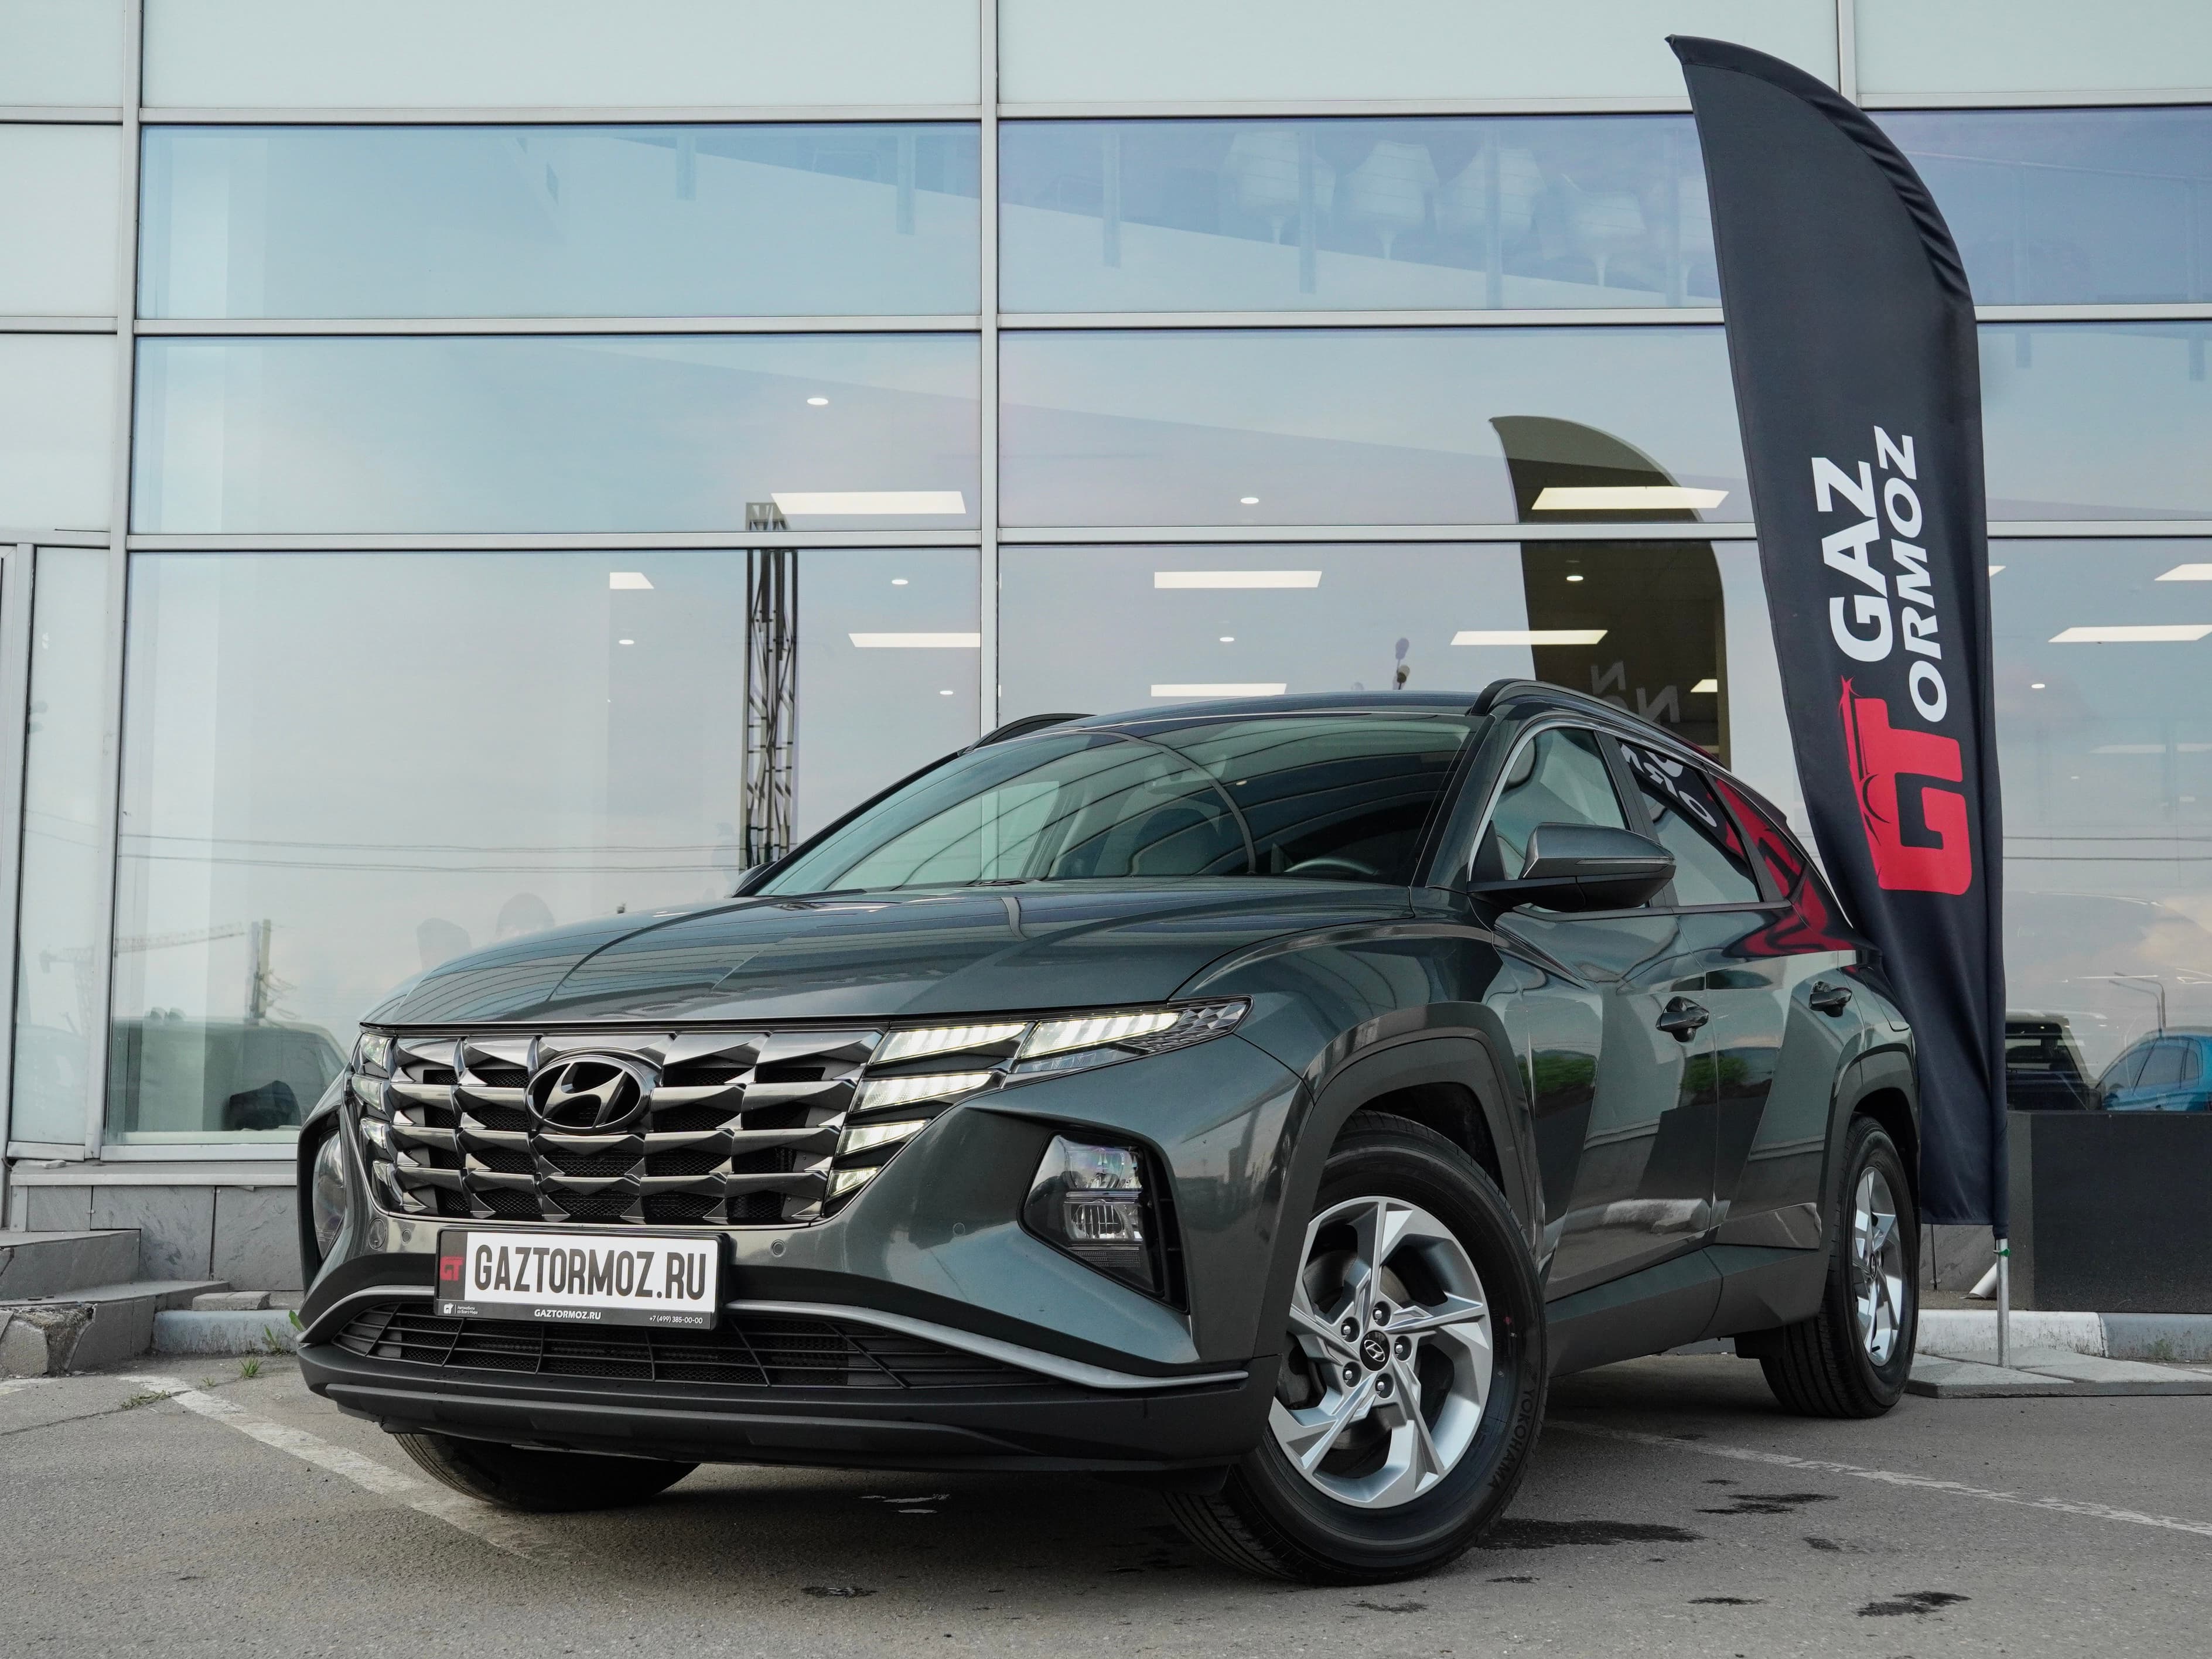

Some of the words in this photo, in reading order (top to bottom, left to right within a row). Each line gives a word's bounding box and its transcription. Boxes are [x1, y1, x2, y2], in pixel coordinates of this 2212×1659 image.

[1811, 457, 1893, 662] GAZ
[1874, 425, 1947, 722] ORMOZ
[474, 1244, 706, 1300] GAZTORMOZ.RU
[534, 1309, 601, 1320] GAZTORMOZ.RU
[657, 1315, 671, 1323] (499)
[672, 1316, 703, 1325] 385-00-00
[1489, 1388, 1535, 1490] YOKOHAMA
